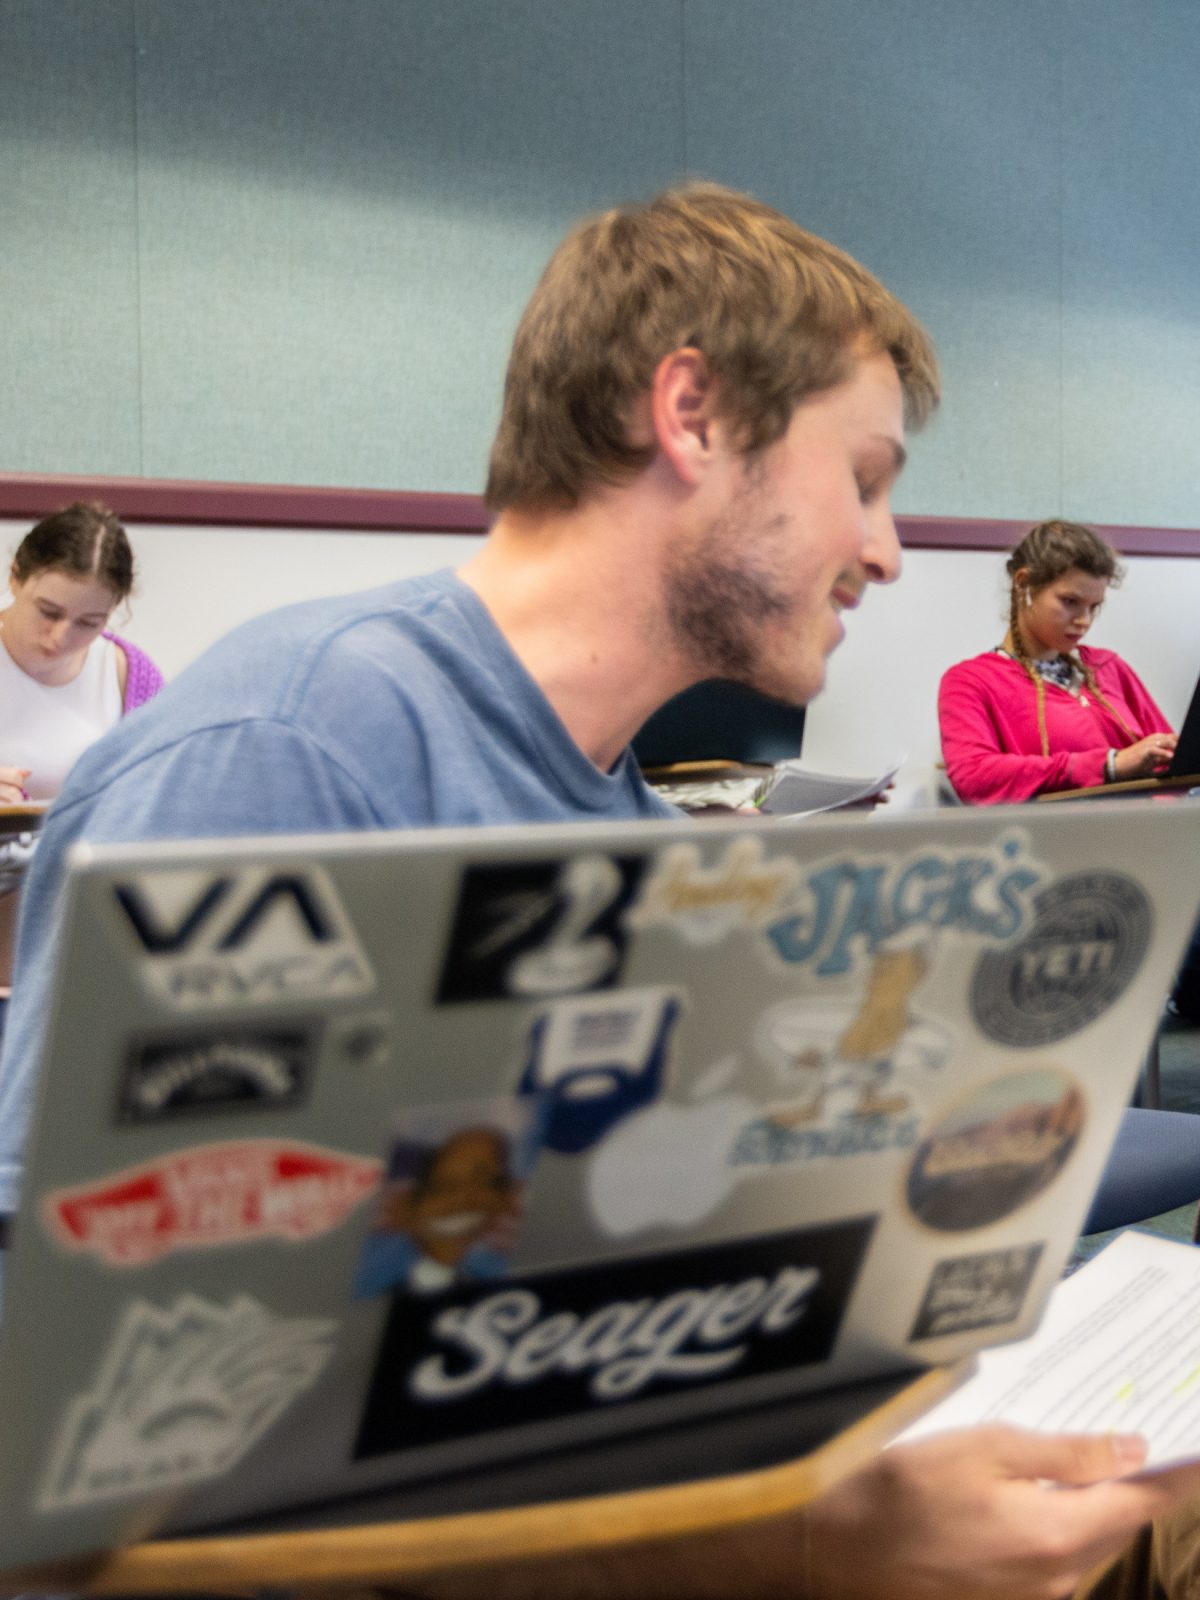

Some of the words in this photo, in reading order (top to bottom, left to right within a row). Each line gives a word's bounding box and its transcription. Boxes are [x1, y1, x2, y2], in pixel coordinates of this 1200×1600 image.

[767, 839, 1040, 977] JACK'S
[167, 954, 364, 997] RVCA
[1019, 941, 1115, 980] YETI
[409, 1266, 821, 1398] Seager
